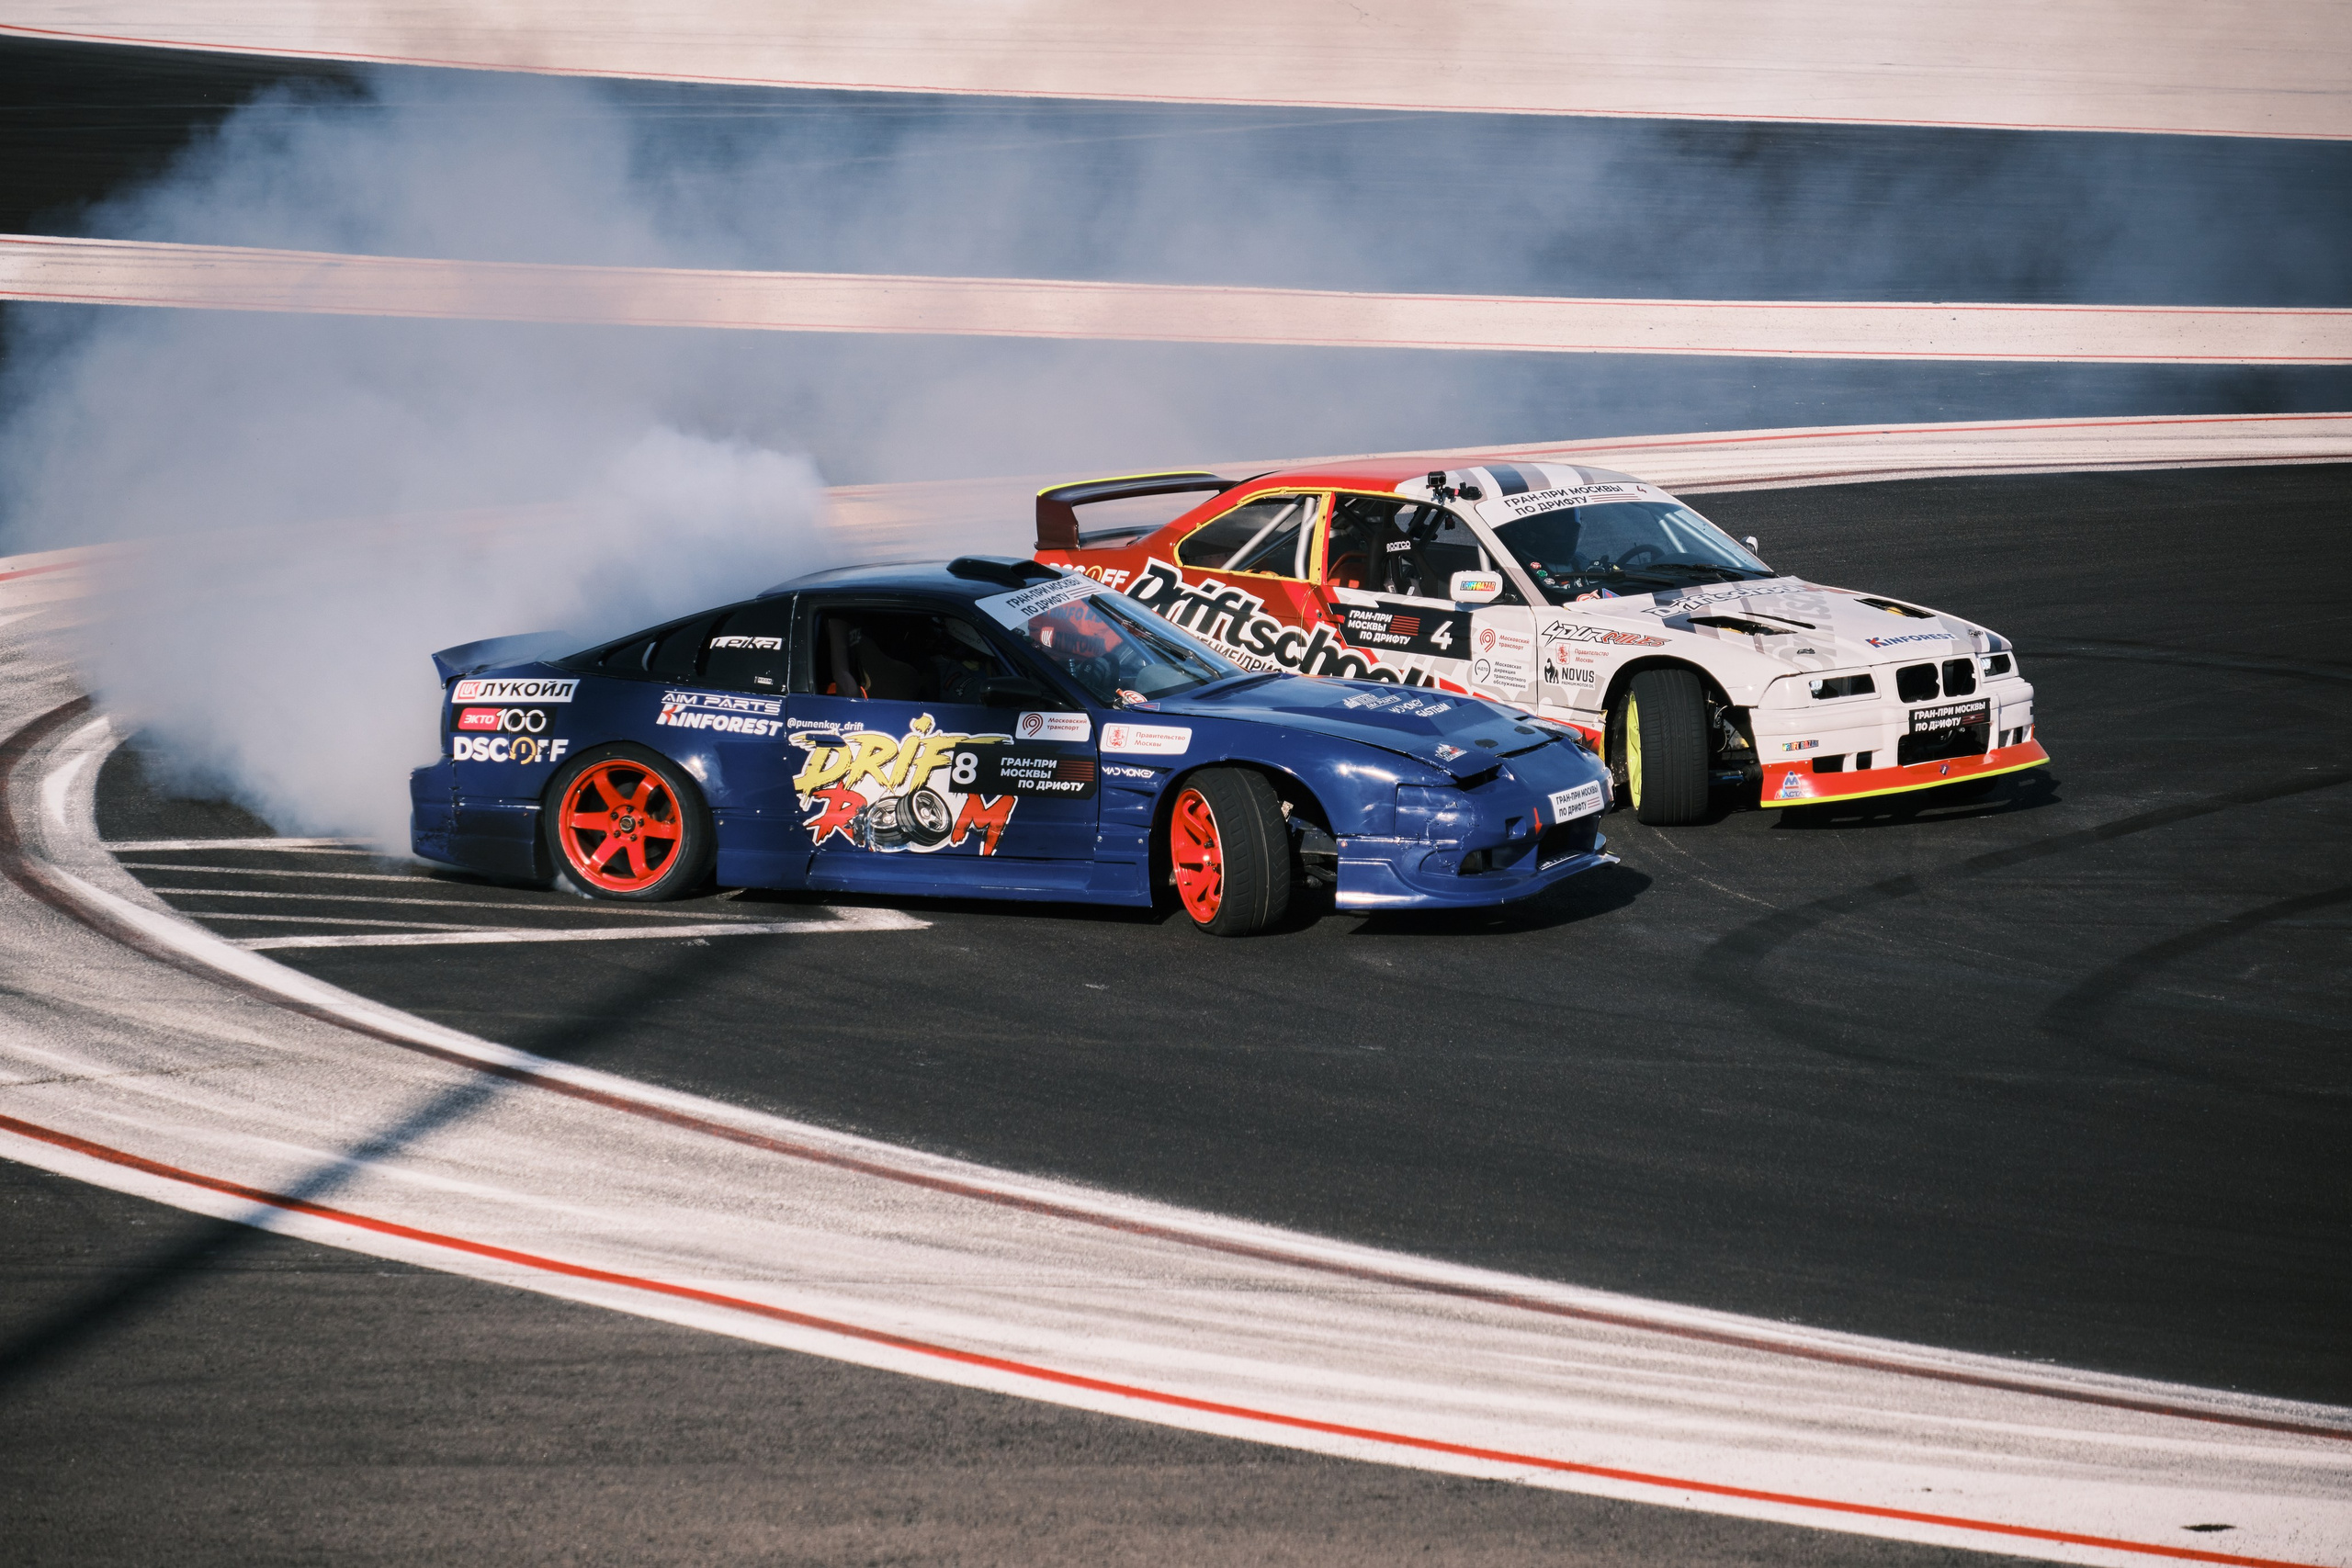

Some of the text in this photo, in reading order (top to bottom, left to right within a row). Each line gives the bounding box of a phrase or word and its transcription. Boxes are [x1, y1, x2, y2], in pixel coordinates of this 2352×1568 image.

[1503, 485, 1623, 508] ГРАН-ПРИ МОСКВЫ
[1635, 485, 1647, 494] 4
[1515, 496, 1589, 516] ПО ДРИФТУ
[1006, 585, 1050, 608] ГРАН-ПРИ
[1049, 577, 1083, 592] МОСКВЫ
[1021, 591, 1071, 616] ПО ДРИФТУ
[1349, 610, 1393, 622] ГРАН-ПРИ
[1348, 619, 1386, 632] МОСКВЫ
[1360, 631, 1411, 645] ПО ДРИФТУ
[1430, 620, 1453, 650] 4
[1498, 634, 1531, 645] Московский
[1865, 632, 1956, 649] KINFOREST
[1498, 641, 1524, 650] транспорт
[1574, 648, 1610, 657] Правительство
[1495, 661, 1521, 670] Московская
[1493, 673, 1526, 683] транспортного
[1562, 667, 1595, 683] NOVUS
[480, 681, 573, 697] ЛУКОЙЛ
[661, 692, 782, 715] AIM PARTS
[1914, 702, 1986, 720] ГРАН-ПРИ МОСКВЫ
[463, 708, 547, 733] ЭКТО 100
[655, 703, 784, 737] KINFOREST
[1046, 724, 1080, 732] транспорт
[1915, 716, 1962, 732] ПО ДРИФТУ
[1134, 739, 1162, 748] Москвы
[1136, 731, 1186, 742] Правительство
[951, 752, 978, 784] 8
[1001, 757, 1057, 769] ГРАН-ПРИ
[1000, 768, 1052, 779] МОСКВЫ
[1017, 779, 1085, 791] ПО ДРИФТУ
[1555, 784, 1600, 806] ГРАН-ПРИ МОСКВЫ
[1558, 801, 1587, 818] ПО ДРИФТУ
